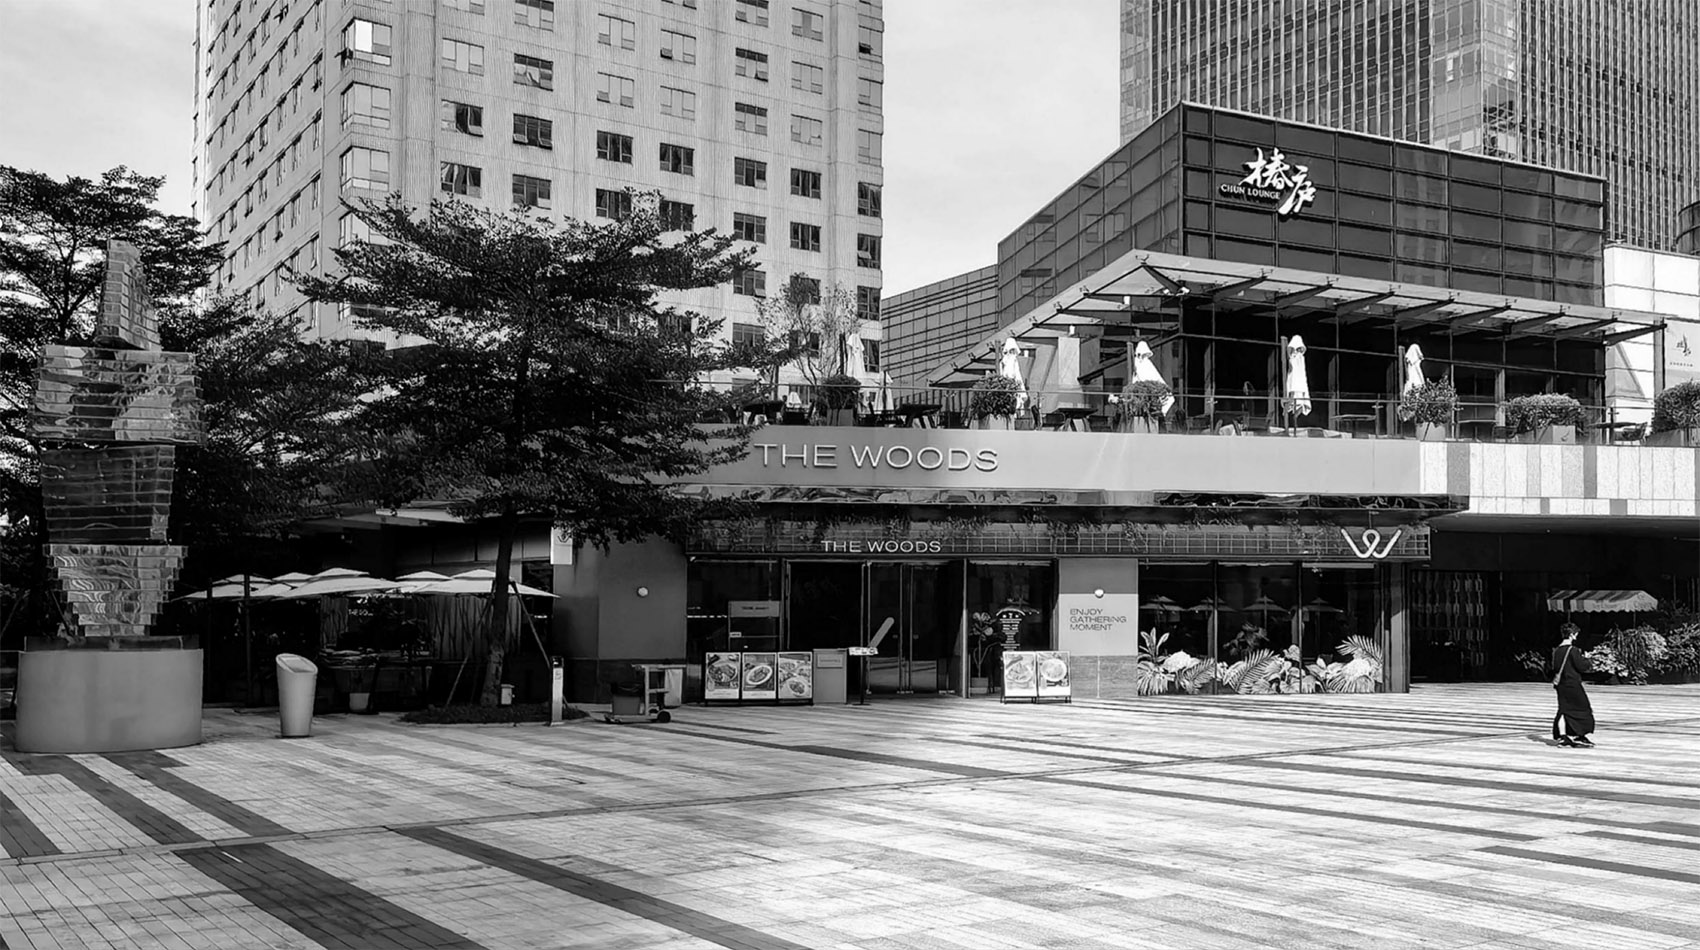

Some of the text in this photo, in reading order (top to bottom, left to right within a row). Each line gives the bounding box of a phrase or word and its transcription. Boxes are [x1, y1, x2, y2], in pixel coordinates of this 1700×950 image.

[1220, 184, 1281, 199] CHUN LOUNGE
[753, 443, 998, 472] THE WOODS
[821, 540, 941, 553] THE WOODS
[1070, 623, 1112, 631] MOMENT
